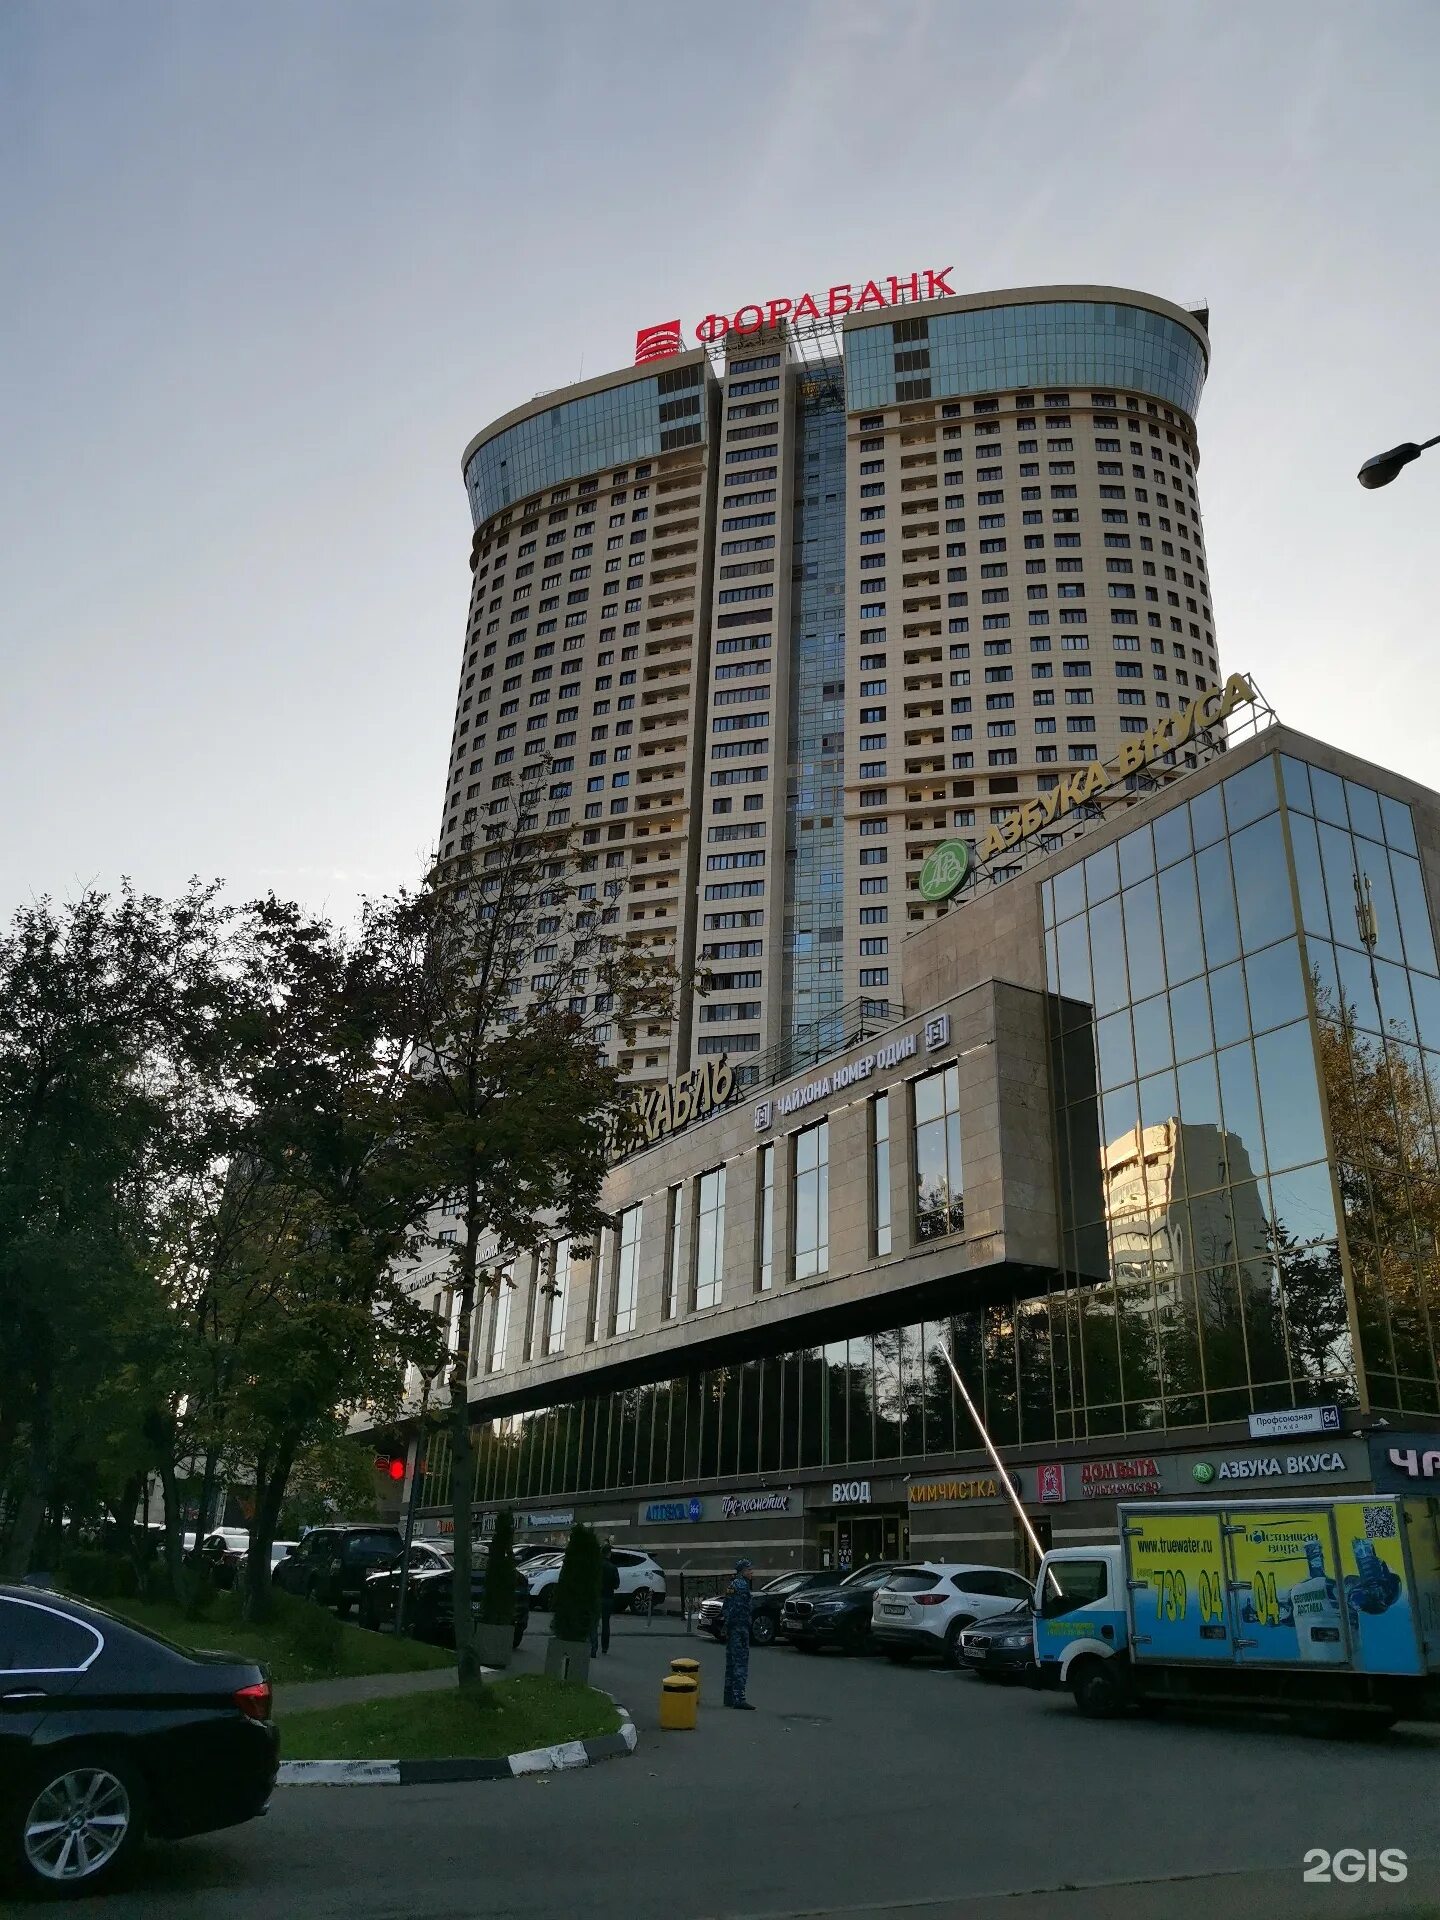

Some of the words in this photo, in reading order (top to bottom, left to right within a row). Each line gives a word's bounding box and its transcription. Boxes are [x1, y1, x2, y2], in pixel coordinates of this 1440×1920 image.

[695, 266, 956, 343] ФОРАБАНК
[979, 761, 1112, 860] АЗБУКА
[1119, 672, 1256, 778] ВКУСА
[777, 1076, 830, 1116] ЧАЙХОНА
[832, 1054, 875, 1090] НОМЕР
[876, 1034, 917, 1070] ОДИН
[1256, 1413, 1313, 1427] Профсоюзная
[1323, 1410, 1337, 1422] 64
[1081, 1463, 1117, 1484] ДОМ
[1219, 1458, 1282, 1479] АЗБУКА
[1287, 1452, 1346, 1474] ВКУСА
[832, 1481, 872, 1504] ВХОД
[908, 1479, 998, 1504] ХИМЧИСТКА
[1137, 1536, 1213, 1554] www.truewater.ru
[1153, 1569, 1187, 1622] 739
[1198, 1569, 1224, 1624] 04
[1253, 1570, 1280, 1625] 04
